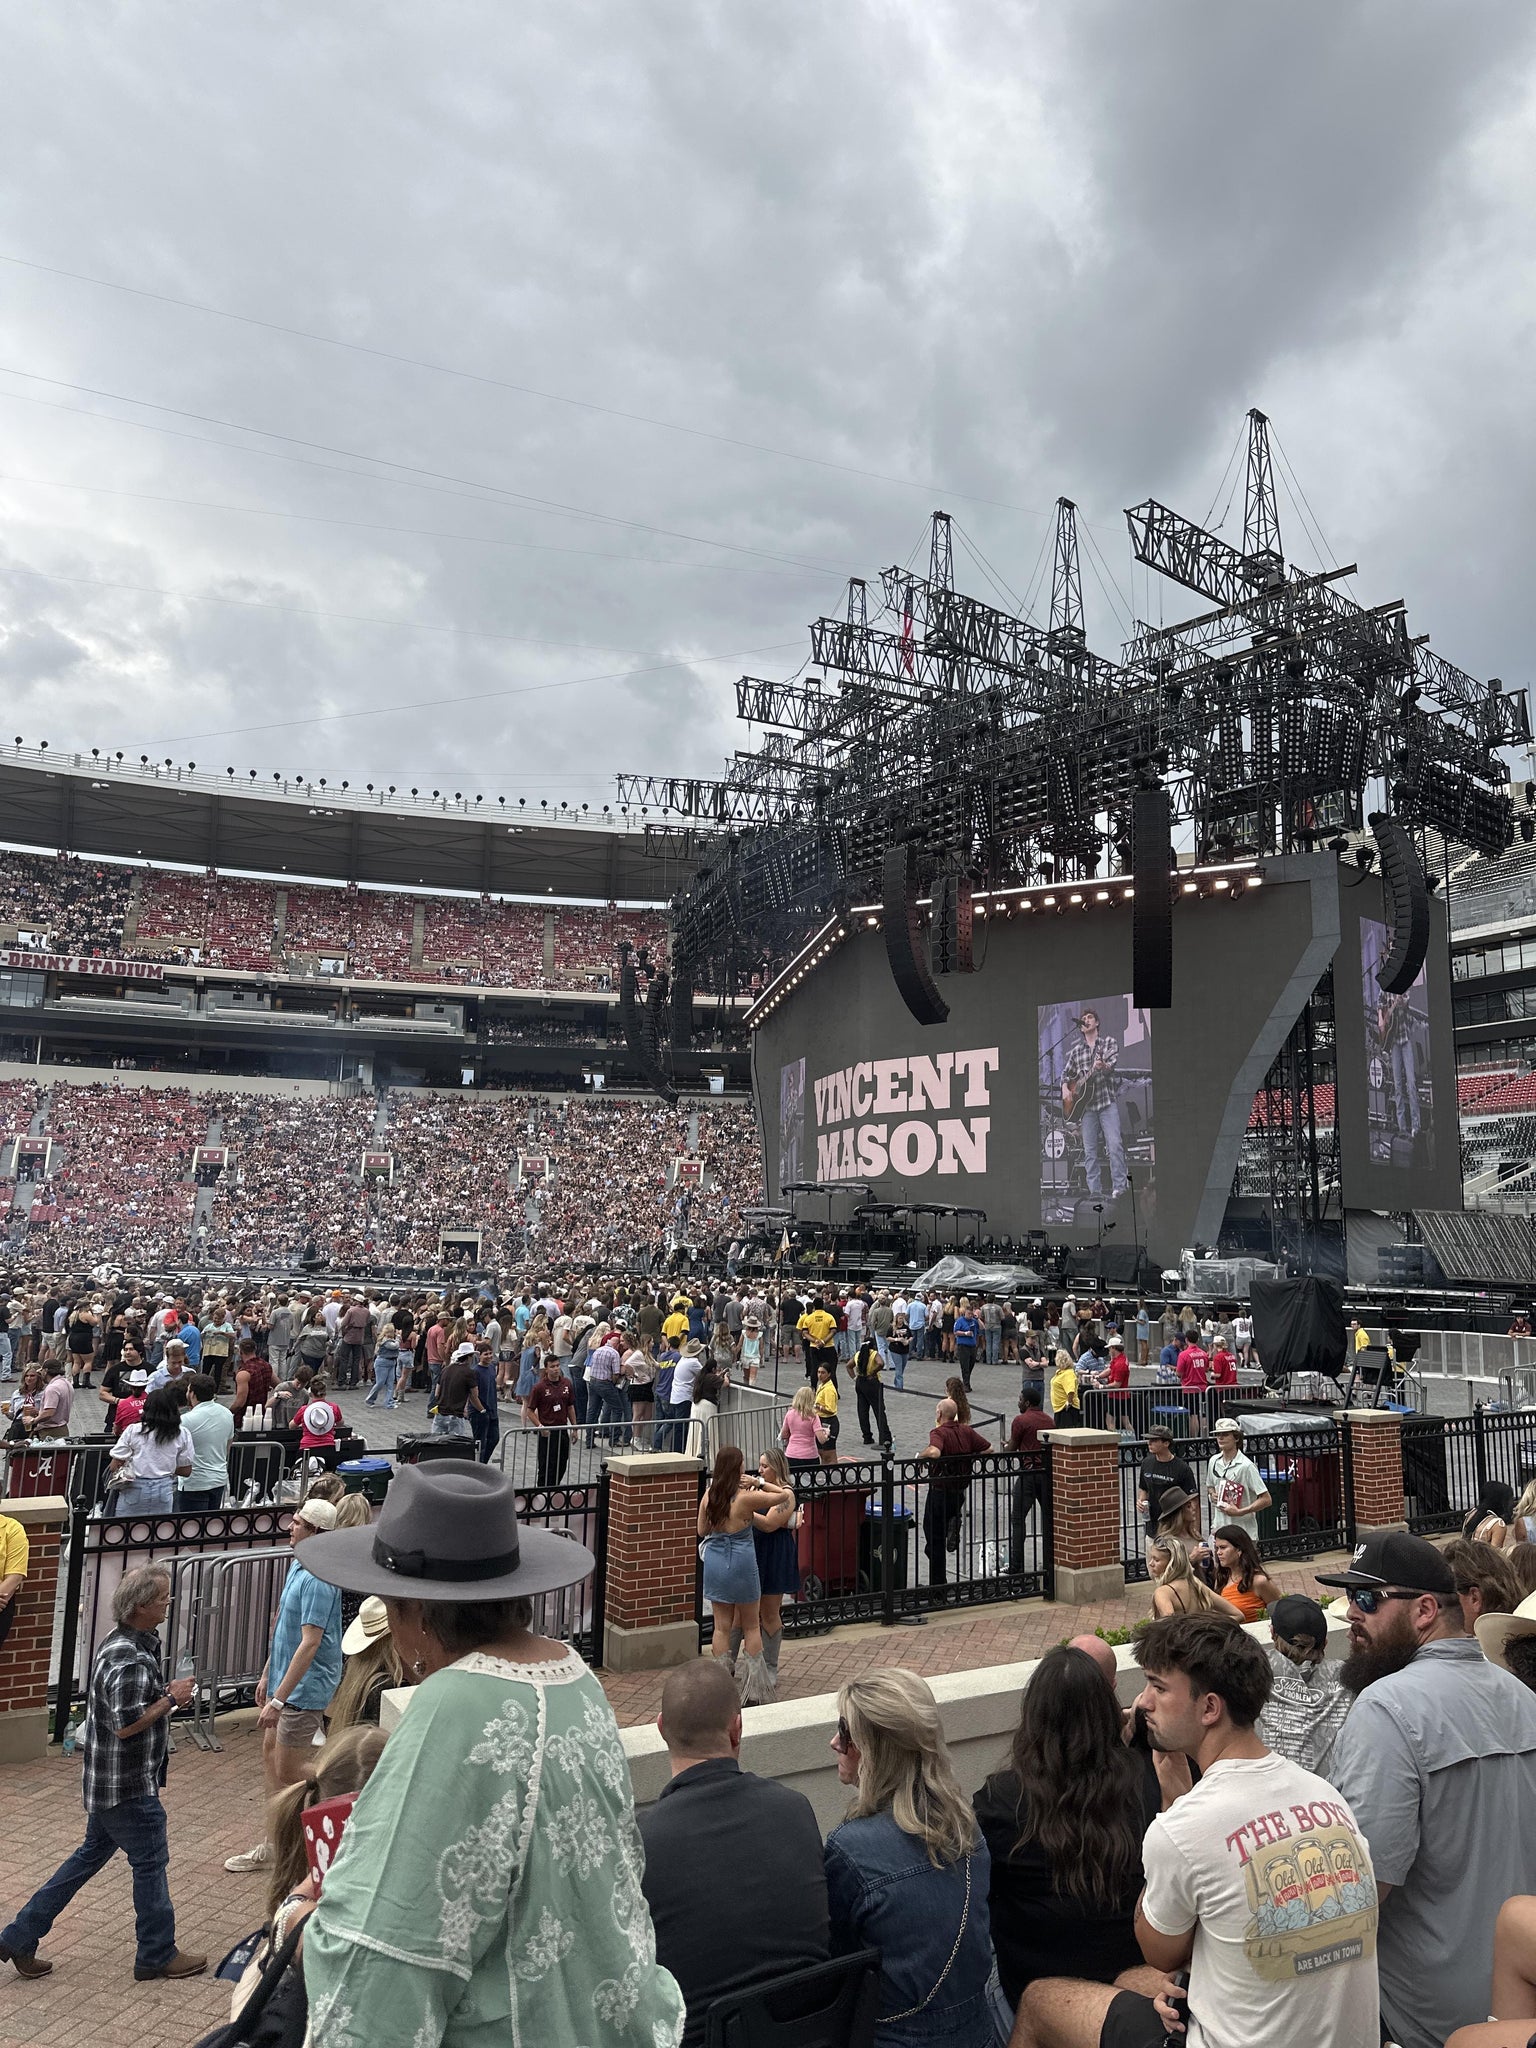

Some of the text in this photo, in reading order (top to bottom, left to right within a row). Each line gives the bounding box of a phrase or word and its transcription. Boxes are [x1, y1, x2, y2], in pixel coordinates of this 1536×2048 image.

[78, 958, 163, 978] STADIUM
[814, 1047, 999, 1127] VINCENT
[817, 1117, 991, 1182] MASON
[1225, 1801, 1357, 1868] THE BOYS
[1305, 1857, 1325, 1877] Old
[1335, 1853, 1353, 1870] Old
[1275, 1868, 1296, 1891] Old
[1298, 1944, 1361, 1971] ARE BACK IN TOWN
